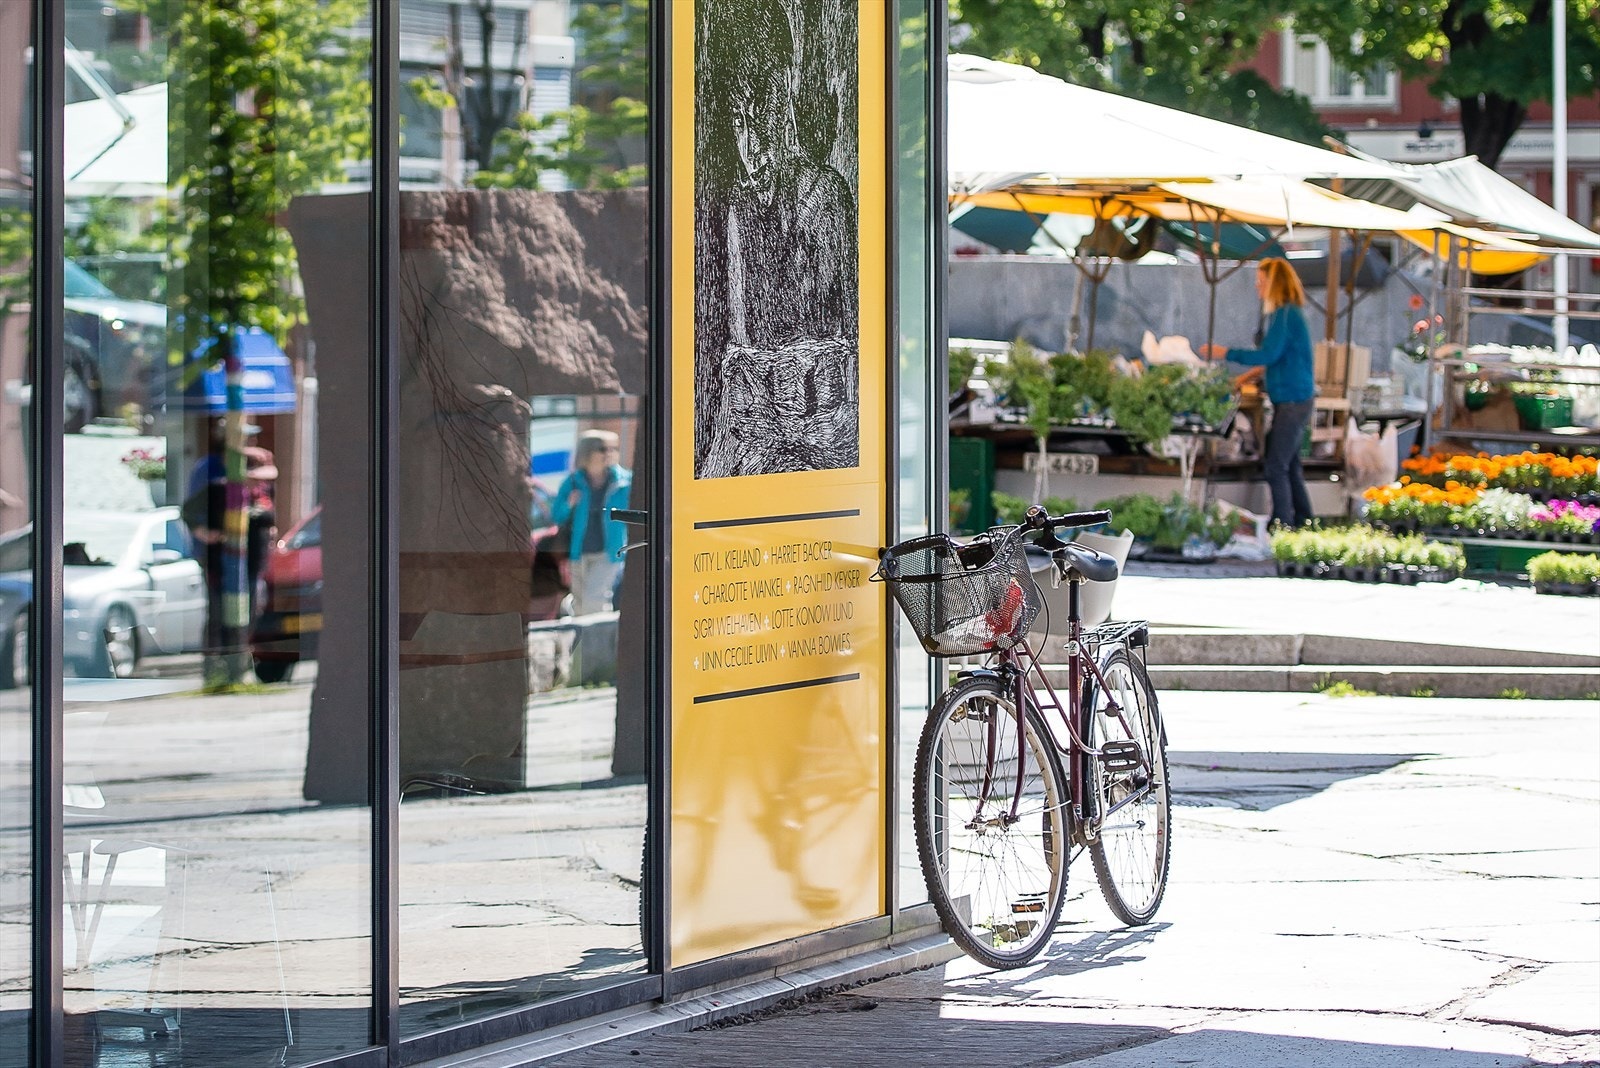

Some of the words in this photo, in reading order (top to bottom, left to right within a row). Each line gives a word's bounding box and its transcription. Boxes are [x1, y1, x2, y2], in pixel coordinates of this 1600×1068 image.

[693, 551, 715, 573] KITTY
[725, 547, 761, 570] KIELLAND
[771, 543, 801, 565] HARRIET
[803, 541, 833, 562] BACKER
[702, 581, 748, 605] CHARLOTTE
[750, 577, 784, 599] WANKEL
[793, 572, 833, 595] RAGNHILD
[834, 569, 861, 590] KEYSER
[693, 617, 715, 640] SIGRI
[716, 612, 762, 636] WELHAVEN
[771, 608, 794, 630] LOTTE
[796, 603, 831, 626] KONOW
[833, 601, 854, 622] LUND
[702, 649, 723, 671] LINN
[787, 637, 817, 659] VANNA
[819, 632, 851, 655] BOWLES
